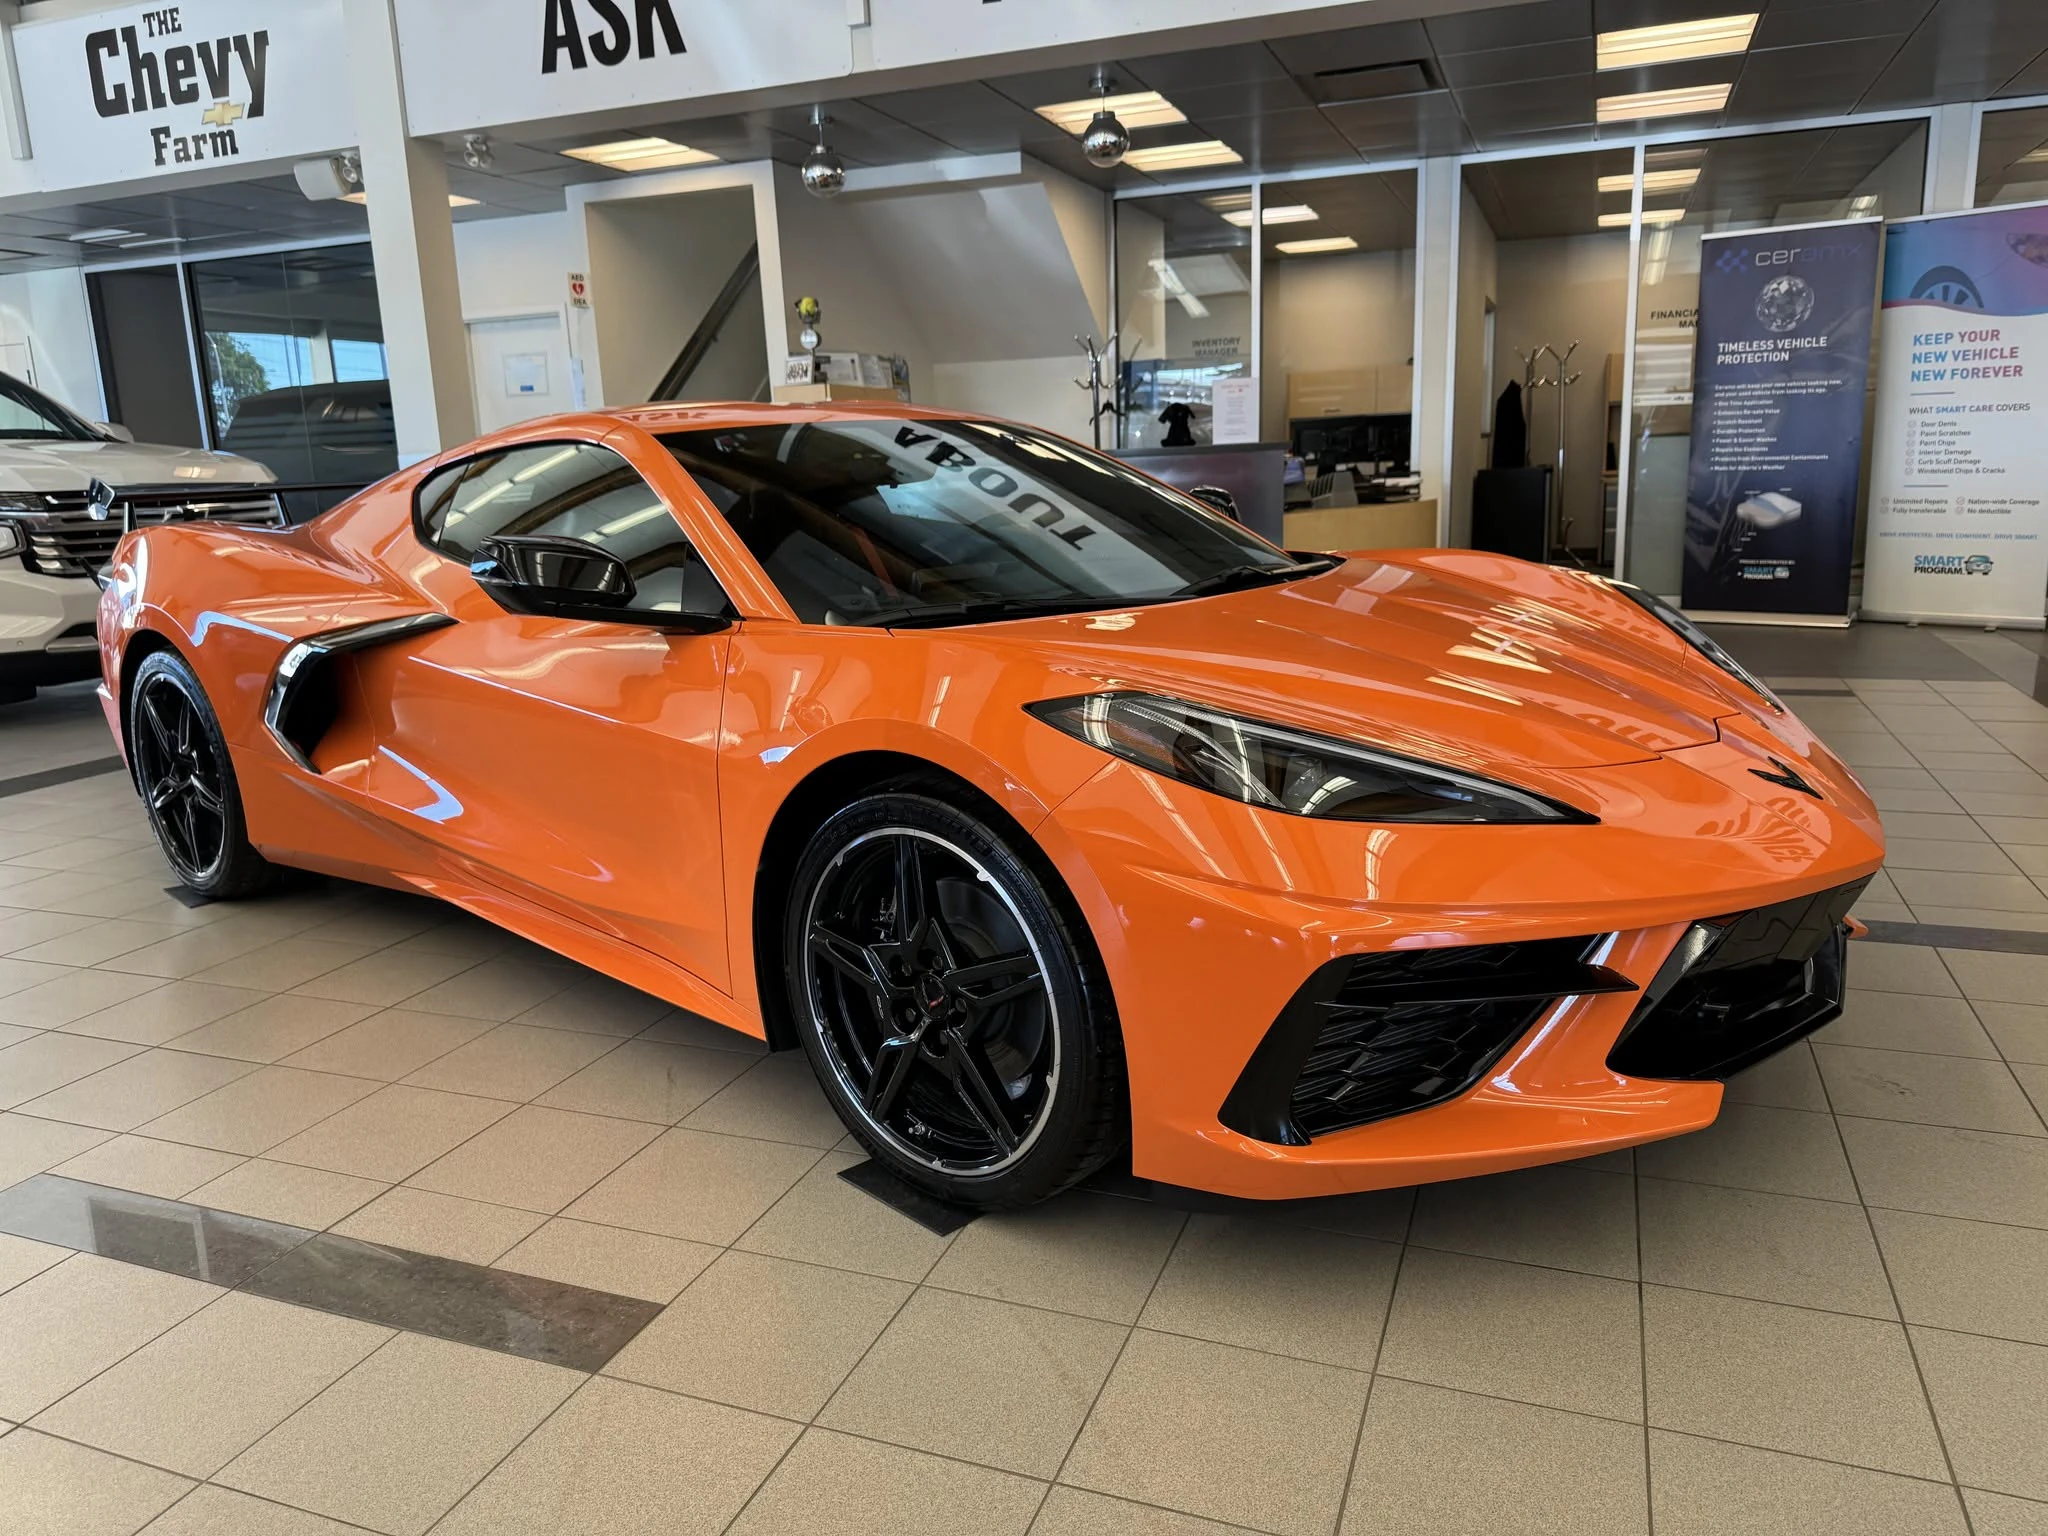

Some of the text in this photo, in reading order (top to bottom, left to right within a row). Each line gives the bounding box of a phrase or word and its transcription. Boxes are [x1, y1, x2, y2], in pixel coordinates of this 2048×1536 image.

[142, 7, 182, 37] THE
[542, 0, 687, 74] ASK
[85, 25, 269, 119] Chevy
[150, 126, 239, 166] Farm
[1192, 337, 1241, 347] INVENTORY
[1717, 337, 1828, 353] TIMELESS VEHICLE
[1913, 329, 2000, 346] KEEP YOUR
[1717, 352, 1789, 365] PROTECTION
[1912, 347, 2019, 364] NEW VEHICLE
[1911, 365, 2023, 382] NEW FOREVER
[1909, 403, 2031, 415] WHAT SMART CARE COVERS
[1924, 498, 1948, 506] Repairs
[1914, 555, 1965, 566] SMART
[1914, 566, 1963, 575] PROGRAM
